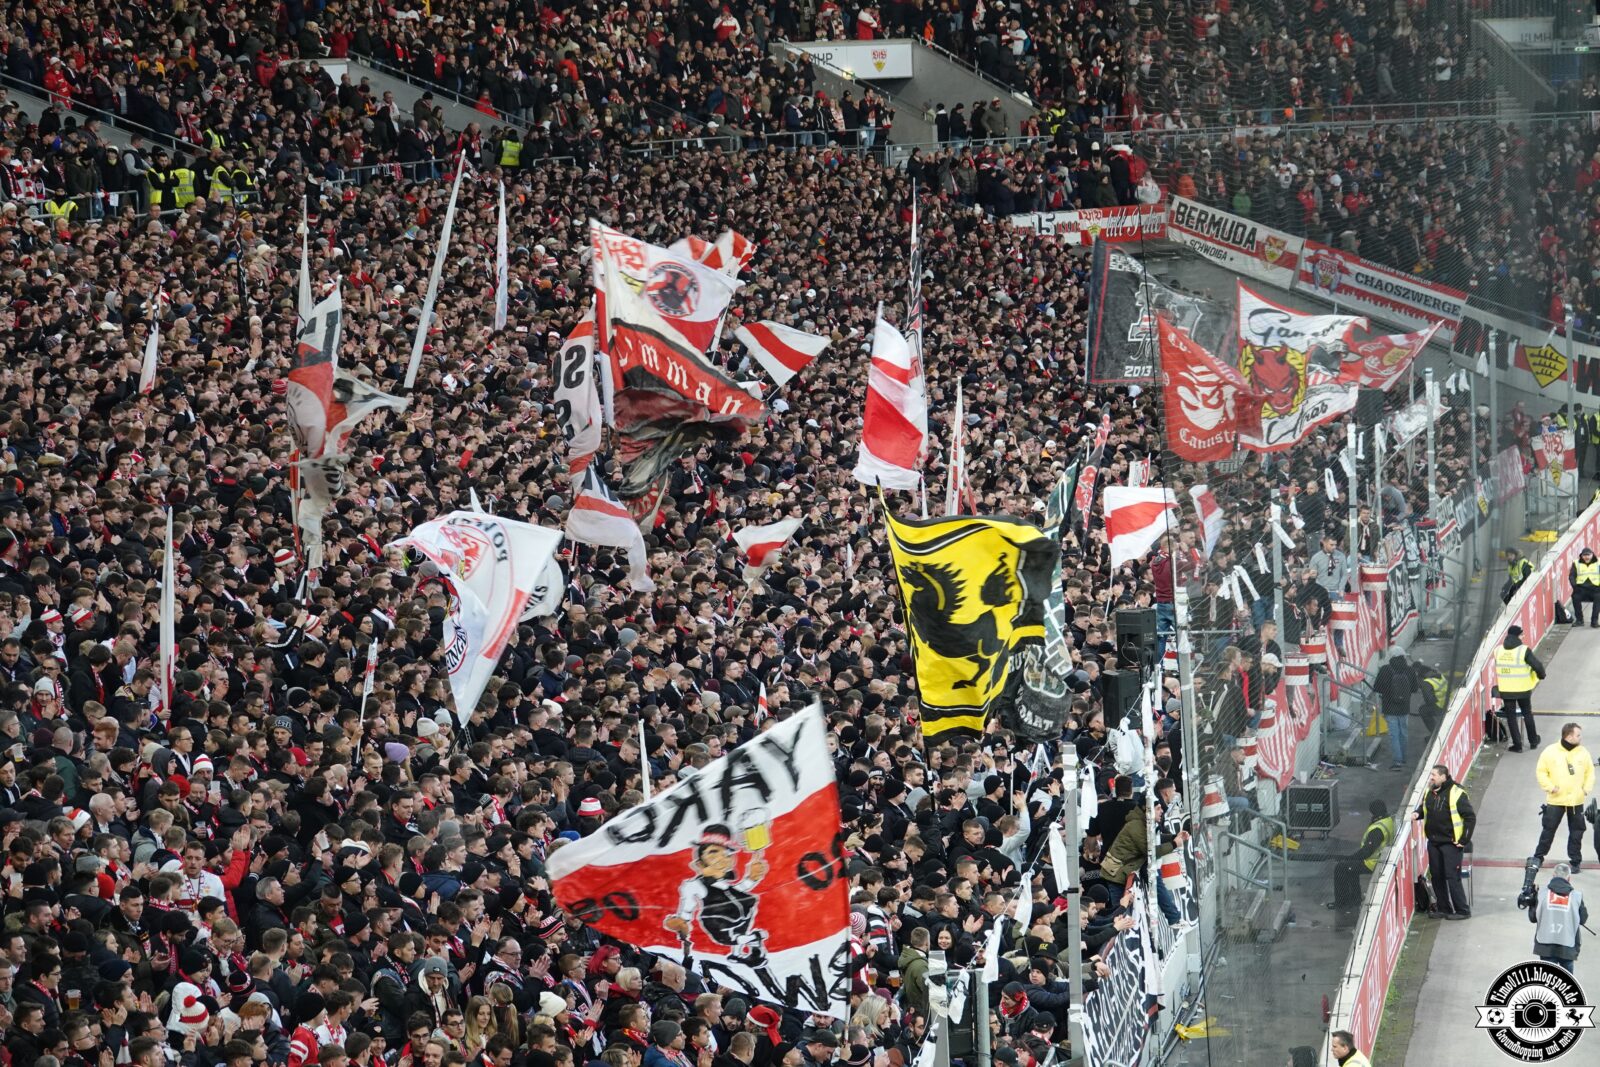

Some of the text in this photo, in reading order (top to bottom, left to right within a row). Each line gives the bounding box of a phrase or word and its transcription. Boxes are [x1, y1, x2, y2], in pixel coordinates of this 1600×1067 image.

[1031, 212, 1056, 237] 15
[1174, 201, 1258, 252] BERMUDA
[1189, 239, 1228, 261] SCHWOIGA
[1355, 272, 1462, 316] CHAOSZWERGE
[1124, 366, 1152, 377] 2013
[1550, 923, 1564, 934] 17
